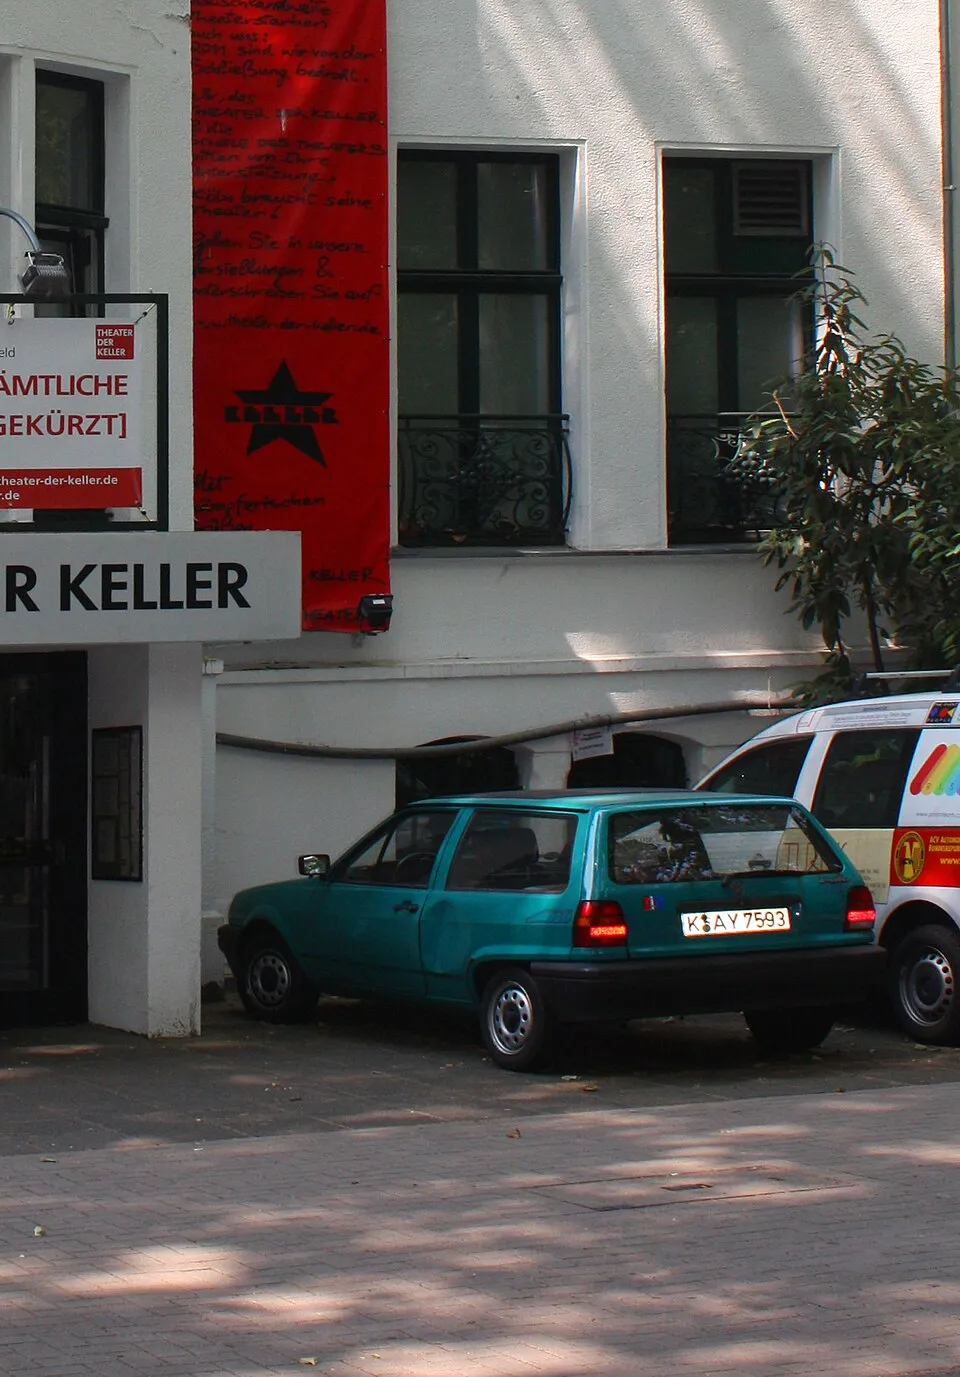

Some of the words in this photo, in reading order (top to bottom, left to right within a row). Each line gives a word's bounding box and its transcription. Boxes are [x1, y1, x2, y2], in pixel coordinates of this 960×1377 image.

[237, 43, 273, 58] sind
[228, 89, 256, 104] das
[206, 121, 233, 136] die
[240, 185, 318, 206] braucht
[248, 230, 279, 250] Sie
[287, 235, 303, 249] in
[315, 255, 335, 279] &
[310, 283, 339, 300] Sie
[98, 348, 125, 356] KELLER
[223, 404, 340, 427] KELLER
[60, 563, 251, 611] KELLER
[688, 916, 699, 931] K
[714, 914, 737, 930] AY
[744, 911, 785, 928] 7593
